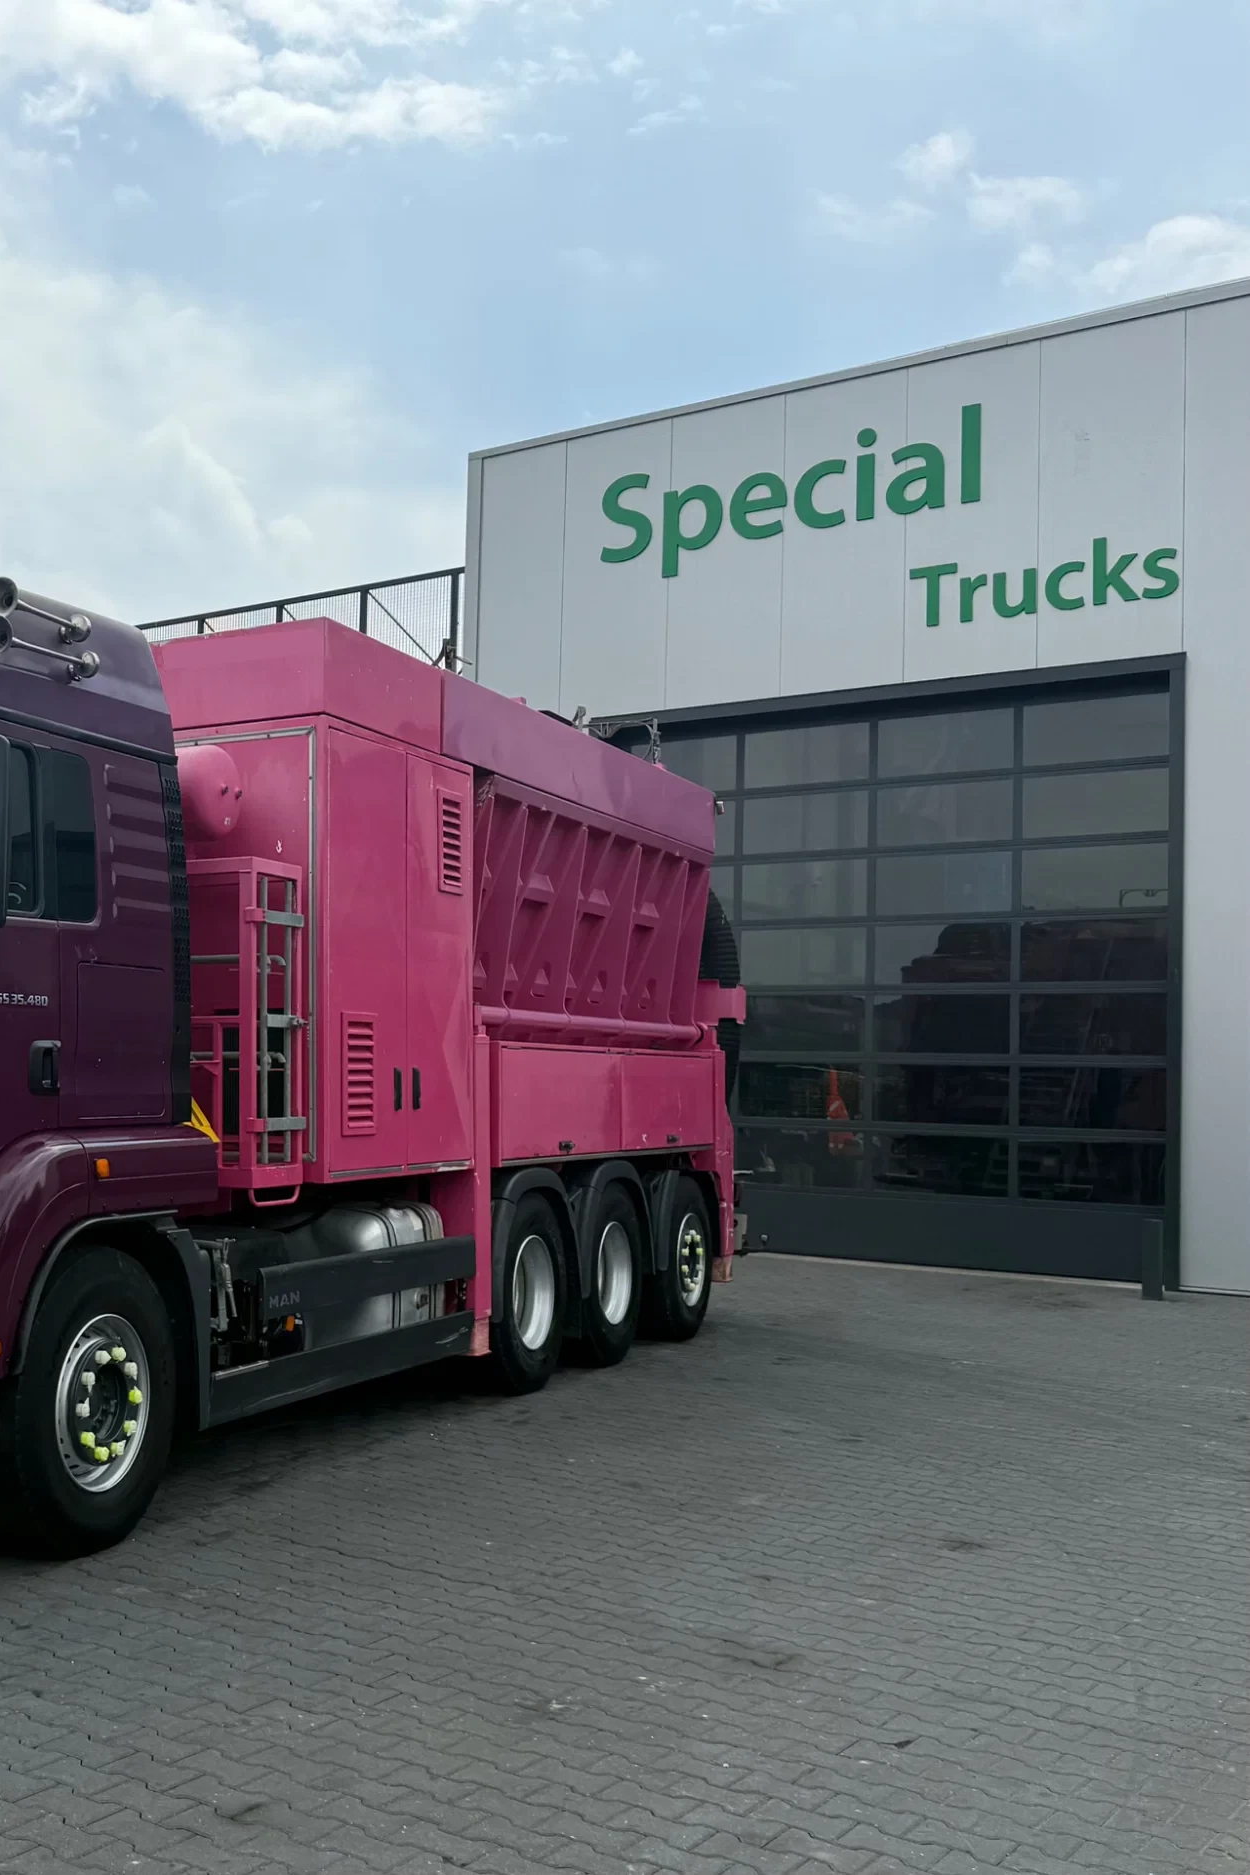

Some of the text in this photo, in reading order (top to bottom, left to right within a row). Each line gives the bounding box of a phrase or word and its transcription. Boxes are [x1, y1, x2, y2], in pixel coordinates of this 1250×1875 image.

[600, 403, 981, 578] Special
[909, 537, 1179, 627] Trucks
[10, 993, 49, 1006] 35.480
[269, 1290, 301, 1309] MAN
